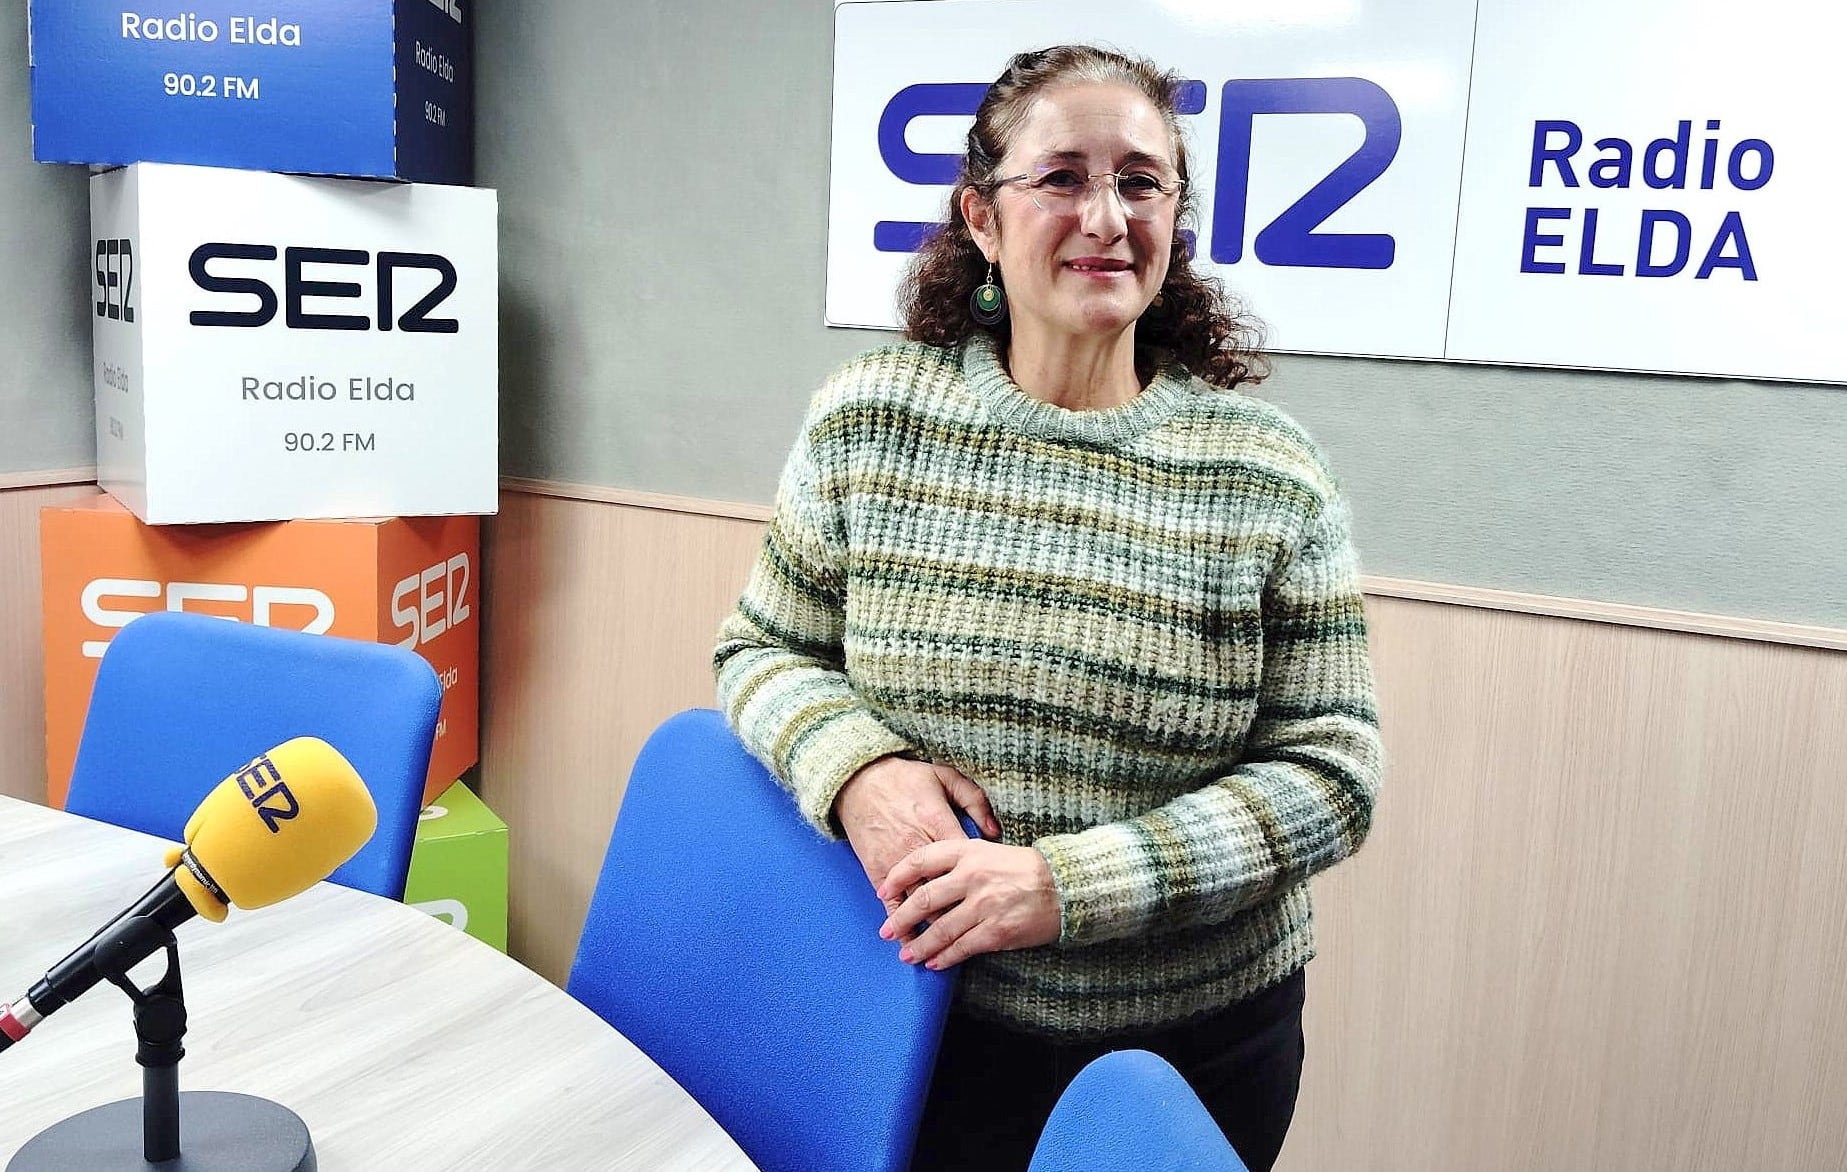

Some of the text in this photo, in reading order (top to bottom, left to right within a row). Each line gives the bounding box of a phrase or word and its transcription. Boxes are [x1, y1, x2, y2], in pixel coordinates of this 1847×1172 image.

[121, 12, 302, 46] Radio Elda
[415, 40, 455, 83] Radio Elda
[163, 72, 260, 100] 90.2 FM
[873, 76, 1402, 270] SR
[1528, 119, 1775, 191] Radio
[1519, 207, 1759, 282] ELDA
[95, 239, 135, 324] SER
[188, 242, 460, 334] SER
[241, 375, 416, 402] Radio Elda
[284, 432, 376, 452] 90.2 FM
[391, 552, 470, 652] SER
[235, 754, 300, 834] ER
